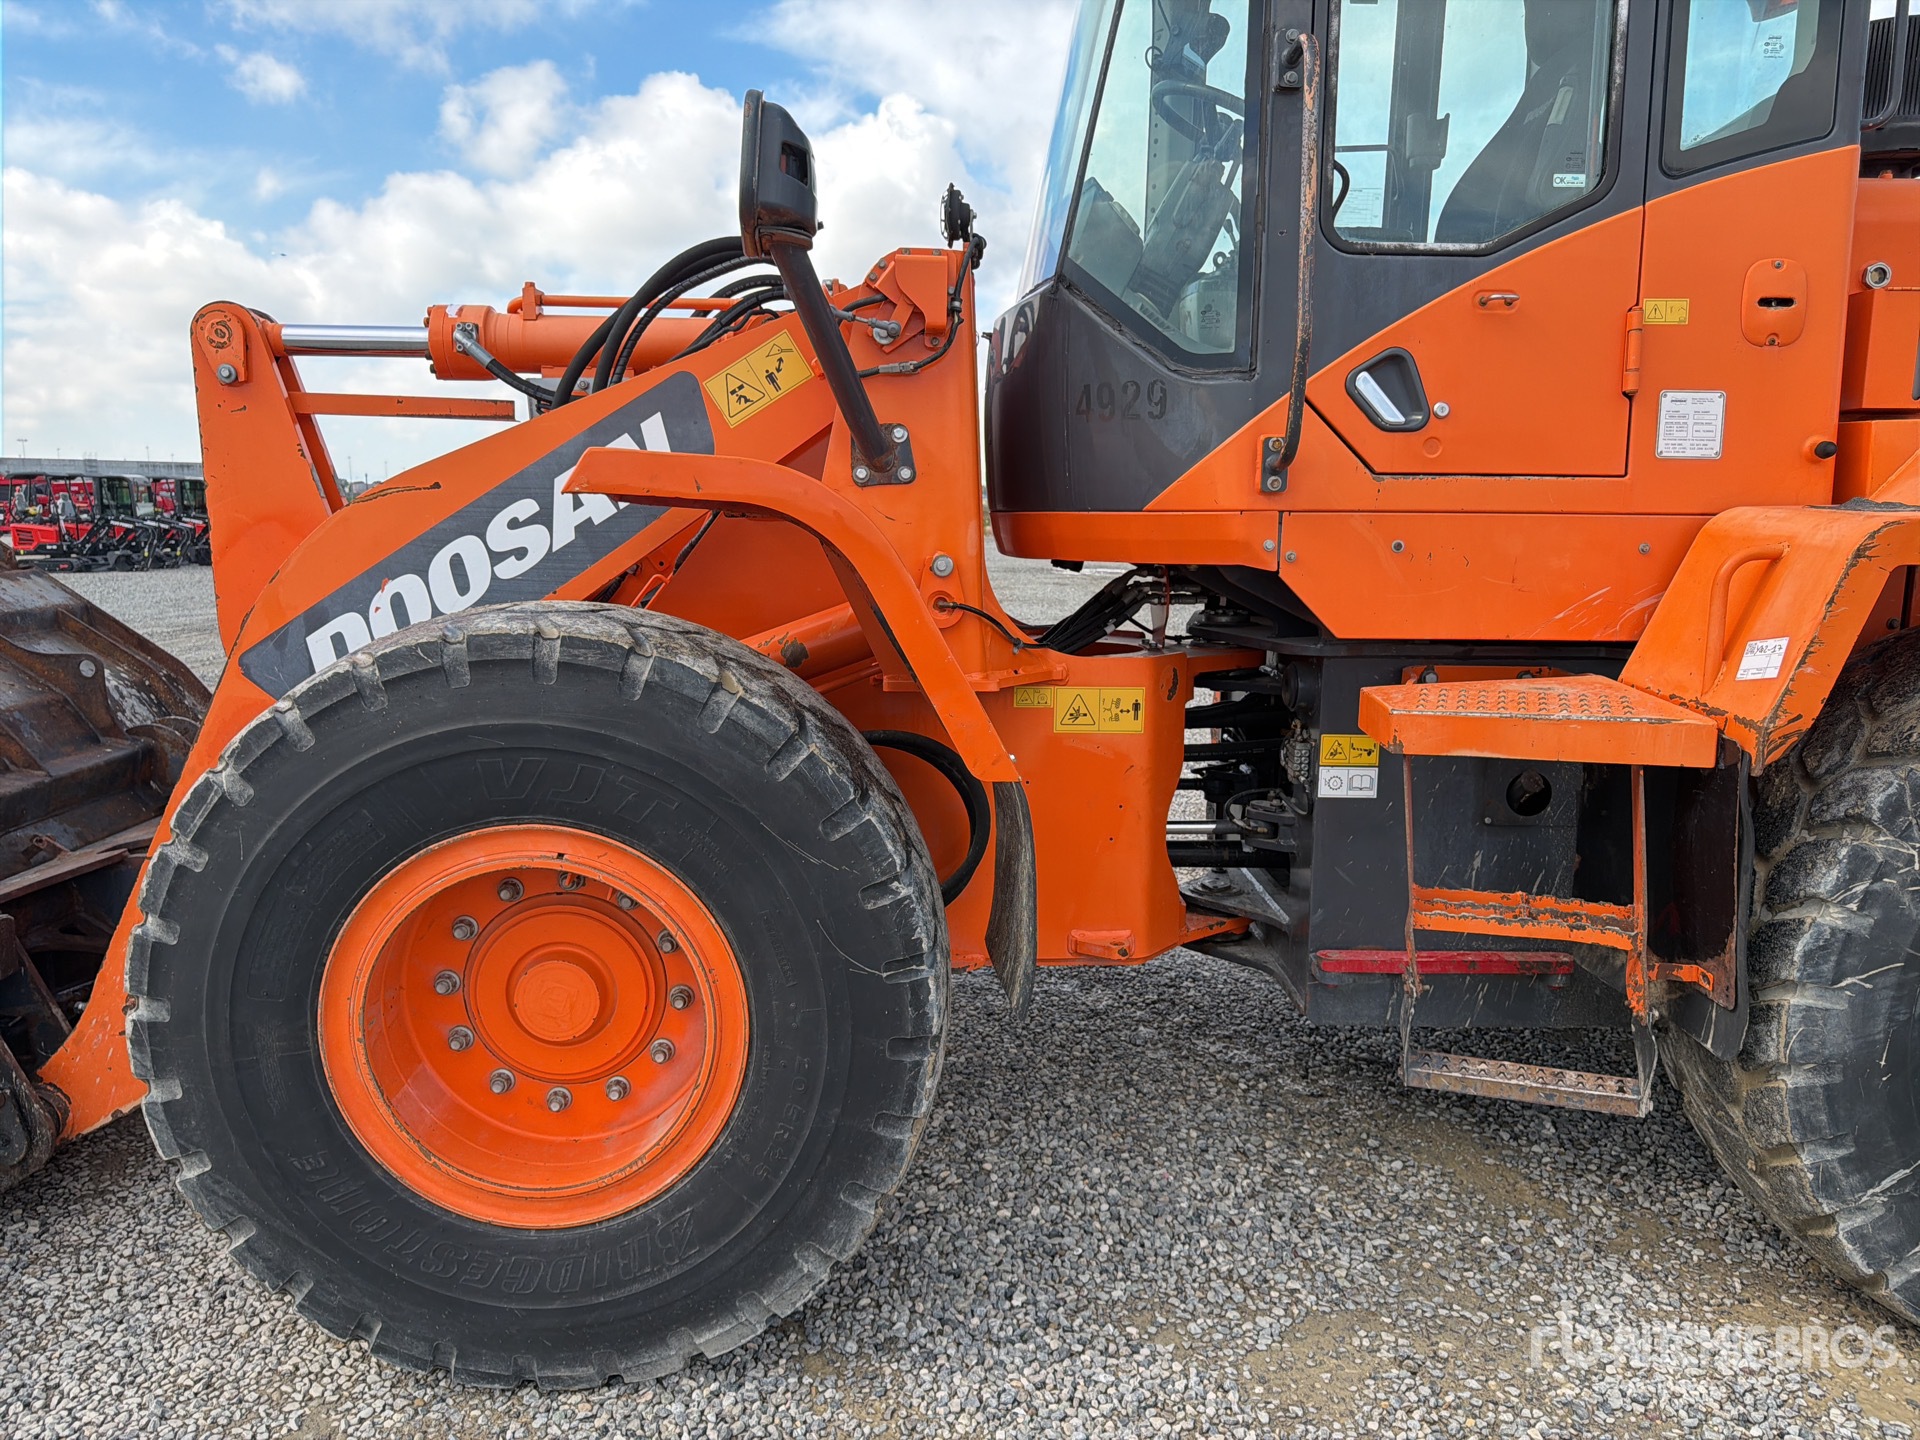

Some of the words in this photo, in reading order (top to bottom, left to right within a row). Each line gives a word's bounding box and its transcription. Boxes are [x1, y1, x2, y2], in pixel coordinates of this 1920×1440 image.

[1554, 176, 1567, 185] OK
[1075, 378, 1168, 423] 4929
[475, 756, 681, 824] VJT
